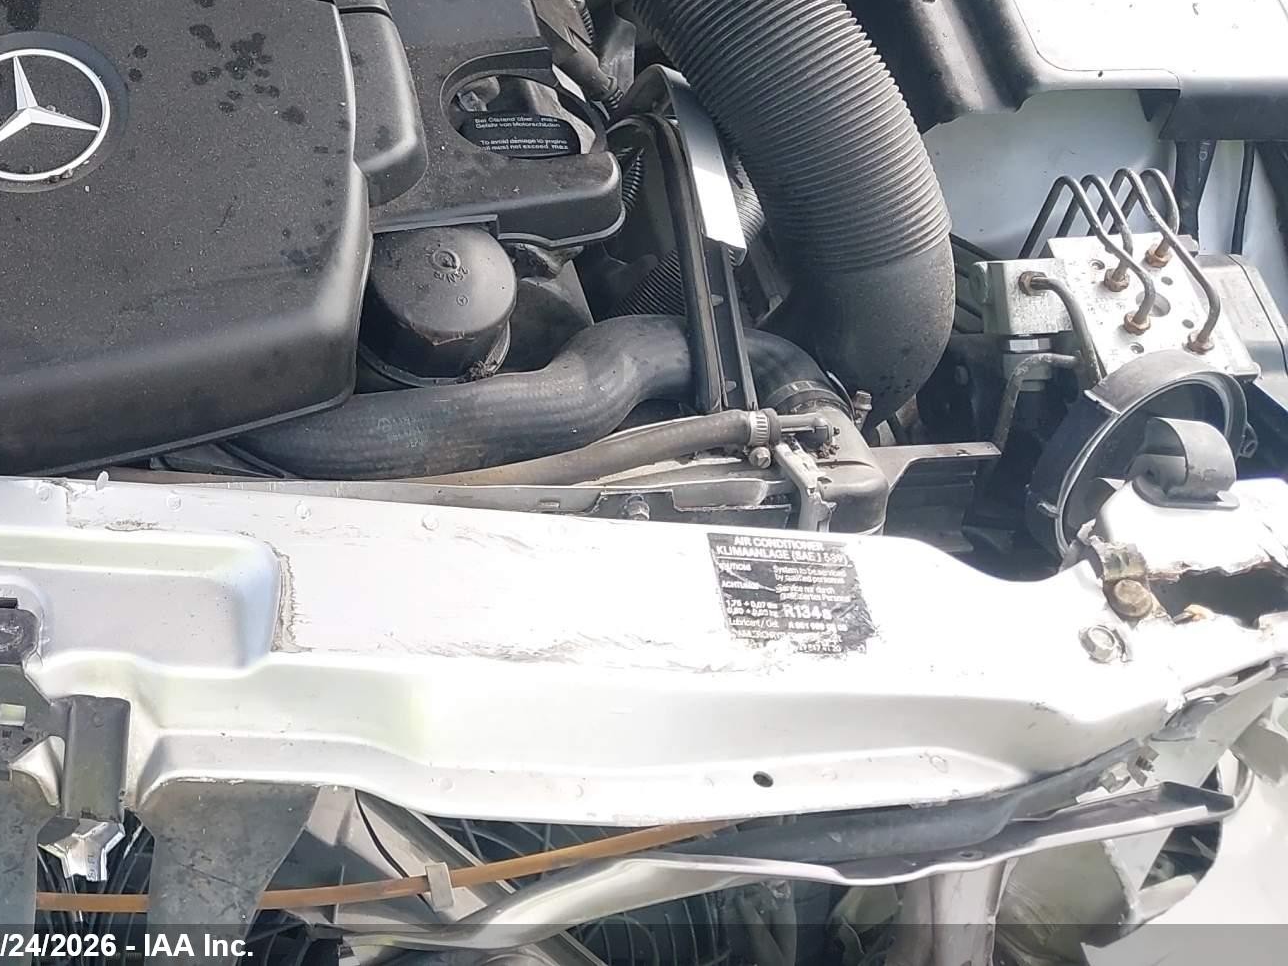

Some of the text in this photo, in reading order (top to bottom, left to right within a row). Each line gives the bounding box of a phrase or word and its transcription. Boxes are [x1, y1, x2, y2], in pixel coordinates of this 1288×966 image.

[734, 536, 824, 551] AIR CONDITIONER
[716, 545, 791, 560] KLIMAANLAGE
